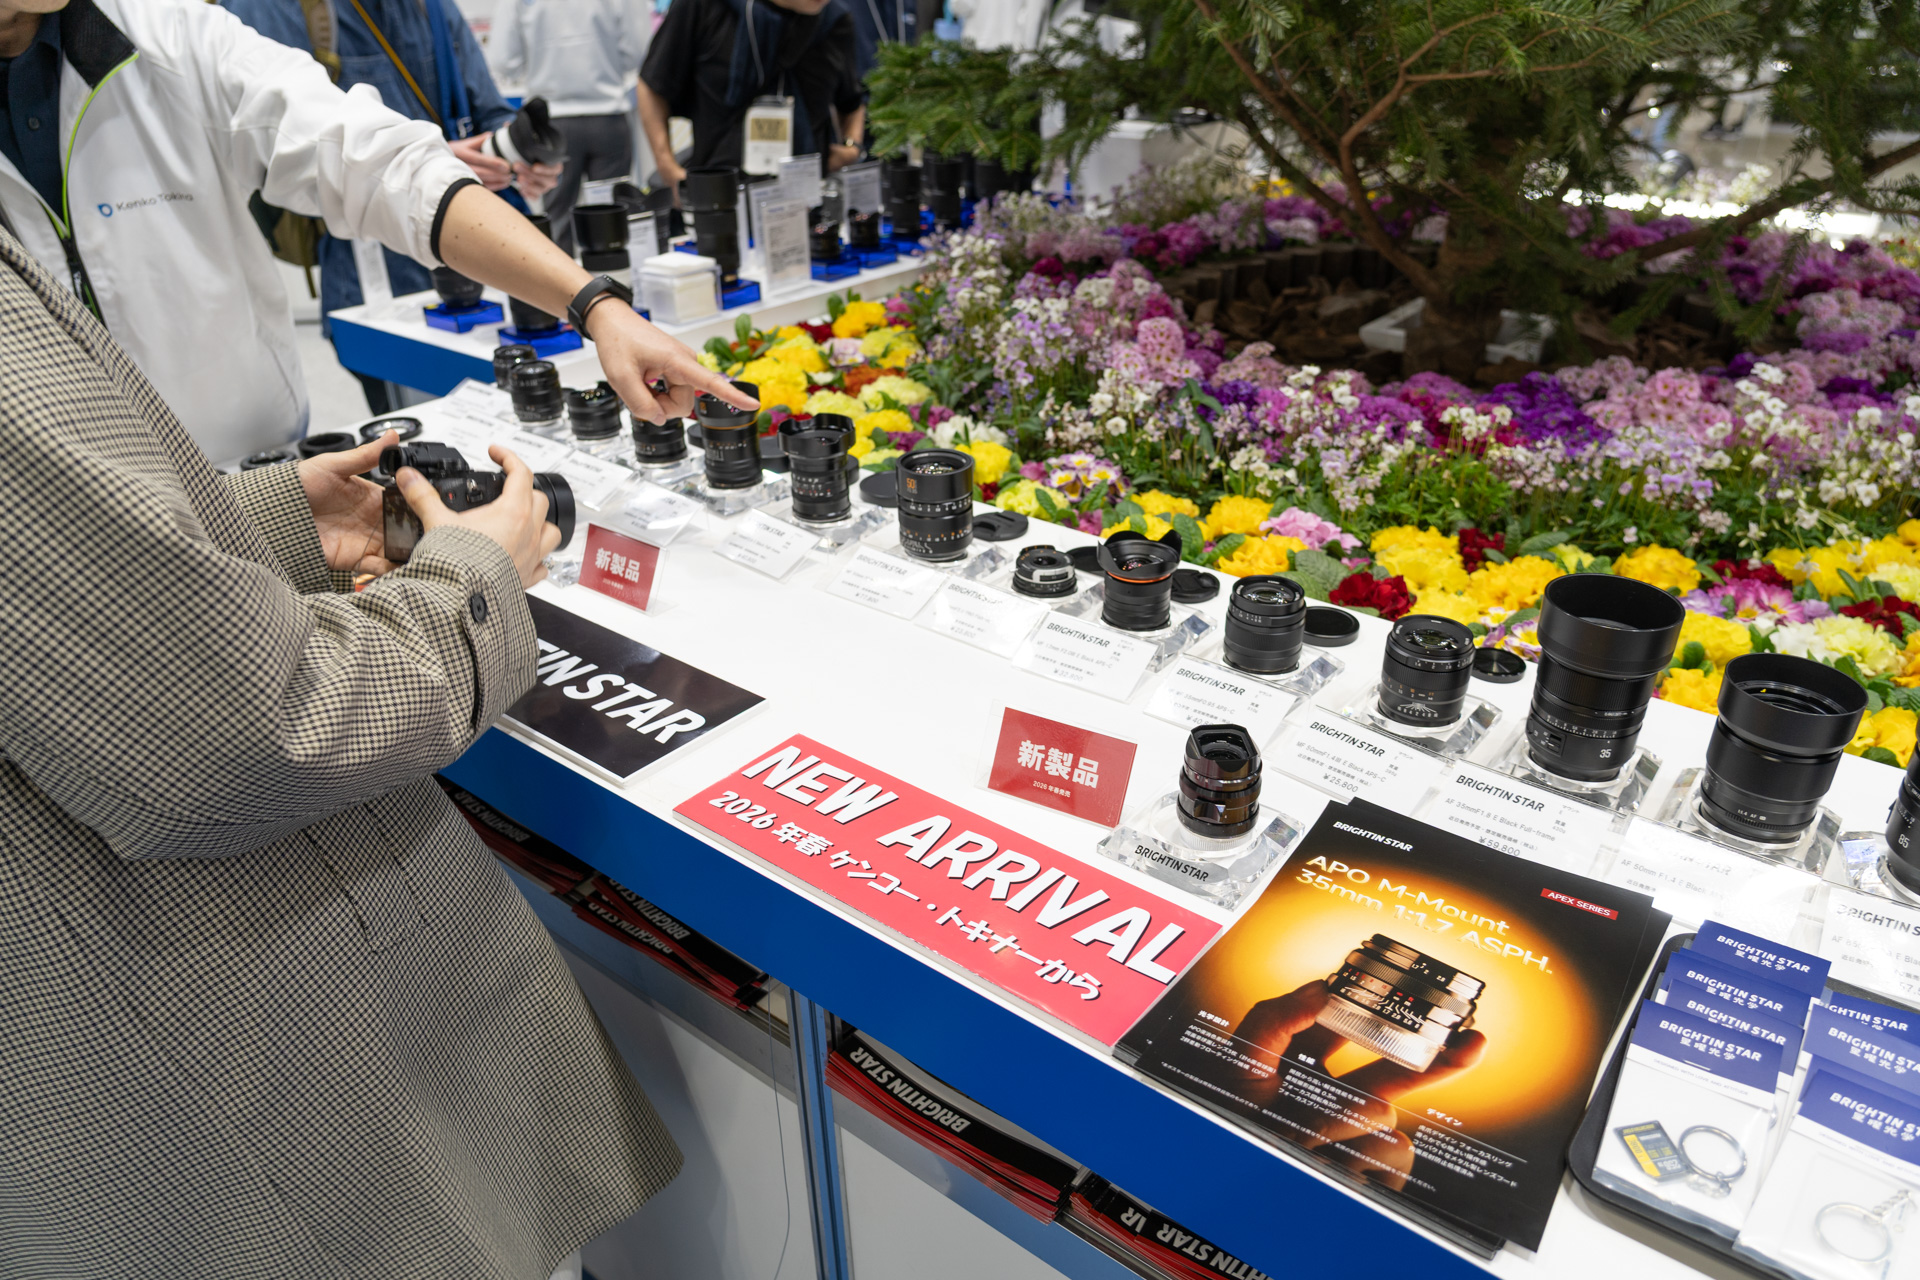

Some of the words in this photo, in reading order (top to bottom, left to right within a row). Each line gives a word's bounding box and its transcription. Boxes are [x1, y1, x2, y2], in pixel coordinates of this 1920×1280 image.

[116, 198, 157, 211] Kenko
[158, 191, 194, 202] Tokina
[906, 478, 916, 489] 50
[595, 547, 640, 583] 新製品
[857, 554, 891, 569] BRIGHTIN
[889, 565, 908, 575] STAR
[1047, 622, 1089, 641] BRIGHTIN
[1087, 635, 1110, 648] STAR
[1177, 668, 1222, 688] BRIGHTIN
[1220, 682, 1245, 696] STAR
[562, 673, 706, 744] STAR
[1310, 721, 1359, 746] BRIGHTIN
[1357, 741, 1385, 757] STAR
[1600, 748, 1612, 759] 35
[1017, 739, 1099, 789] 新製品
[1296, 741, 1306, 749] MF
[1347, 761, 1364, 773] Black
[1365, 767, 1387, 783] APS-C
[1032, 780, 1048, 791] 2026
[1048, 785, 1072, 798] 年春発売
[1323, 772, 1359, 793] ¥25,800
[1456, 774, 1514, 801] BRIGHTIN
[1512, 794, 1545, 812] STAR
[454, 791, 486, 814] STAR
[1445, 797, 1455, 806] AF
[1456, 801, 1491, 819] 35mmF1.8
[1499, 816, 1518, 829] Black
[1519, 823, 1556, 842] Full-frame
[478, 807, 531, 842] BRIGHTIN
[1333, 821, 1387, 845] BRIGHTIN
[1383, 835, 1413, 852] STAR
[1898, 833, 1910, 849] 85
[741, 745, 899, 825] NEW
[875, 815, 1186, 986] ARRIVAL
[1134, 844, 1183, 872] BRIGHTIN
[1181, 864, 1209, 882] STAR
[1621, 858, 1632, 867] AF
[1633, 863, 1657, 877] 50mm
[1685, 881, 1707, 895] Black
[708, 790, 778, 830] 2026
[771, 822, 834, 857] 年春
[829, 850, 1103, 1001] ケンコー・トキナーから
[1306, 855, 1370, 885] APO
[1377, 878, 1510, 937] M-Mount
[1548, 892, 1575, 905] APEX
[1576, 900, 1611, 916] SERIES
[633, 899, 690, 940] BRIGHTIN
[1296, 868, 1383, 912] 35mm
[1391, 904, 1454, 935] 1:1.7
[1456, 930, 1553, 975] ASPH.
[1716, 935, 1777, 962] BRIGHTIN
[1776, 957, 1811, 973] STAR
[1686, 970, 1749, 999] BRIGHTIN
[1748, 994, 1784, 1012] STAR
[1198, 1010, 1230, 1028] 光学設計
[1686, 1000, 1750, 1032] BRIGHTIN
[1750, 1026, 1787, 1046] STAR
[1818, 1001, 1871, 1022] IGHTIN
[1872, 1016, 1908, 1031] STAR
[1659, 1019, 1725, 1049] BRIGHTIN
[1725, 1043, 1762, 1062] STAR
[1828, 1027, 1895, 1062] BRIGHTIN
[1895, 1056, 1920, 1074] STA
[849, 1046, 895, 1084] STAR
[1297, 1053, 1316, 1066] 性能
[886, 1077, 972, 1133] BRIGHTIN
[1321, 1090, 1337, 1101] 0.3m
[1829, 1092, 1905, 1129] BRIGHTIN
[1427, 1107, 1463, 1126] デザイン
[1156, 1223, 1214, 1261] STAR
